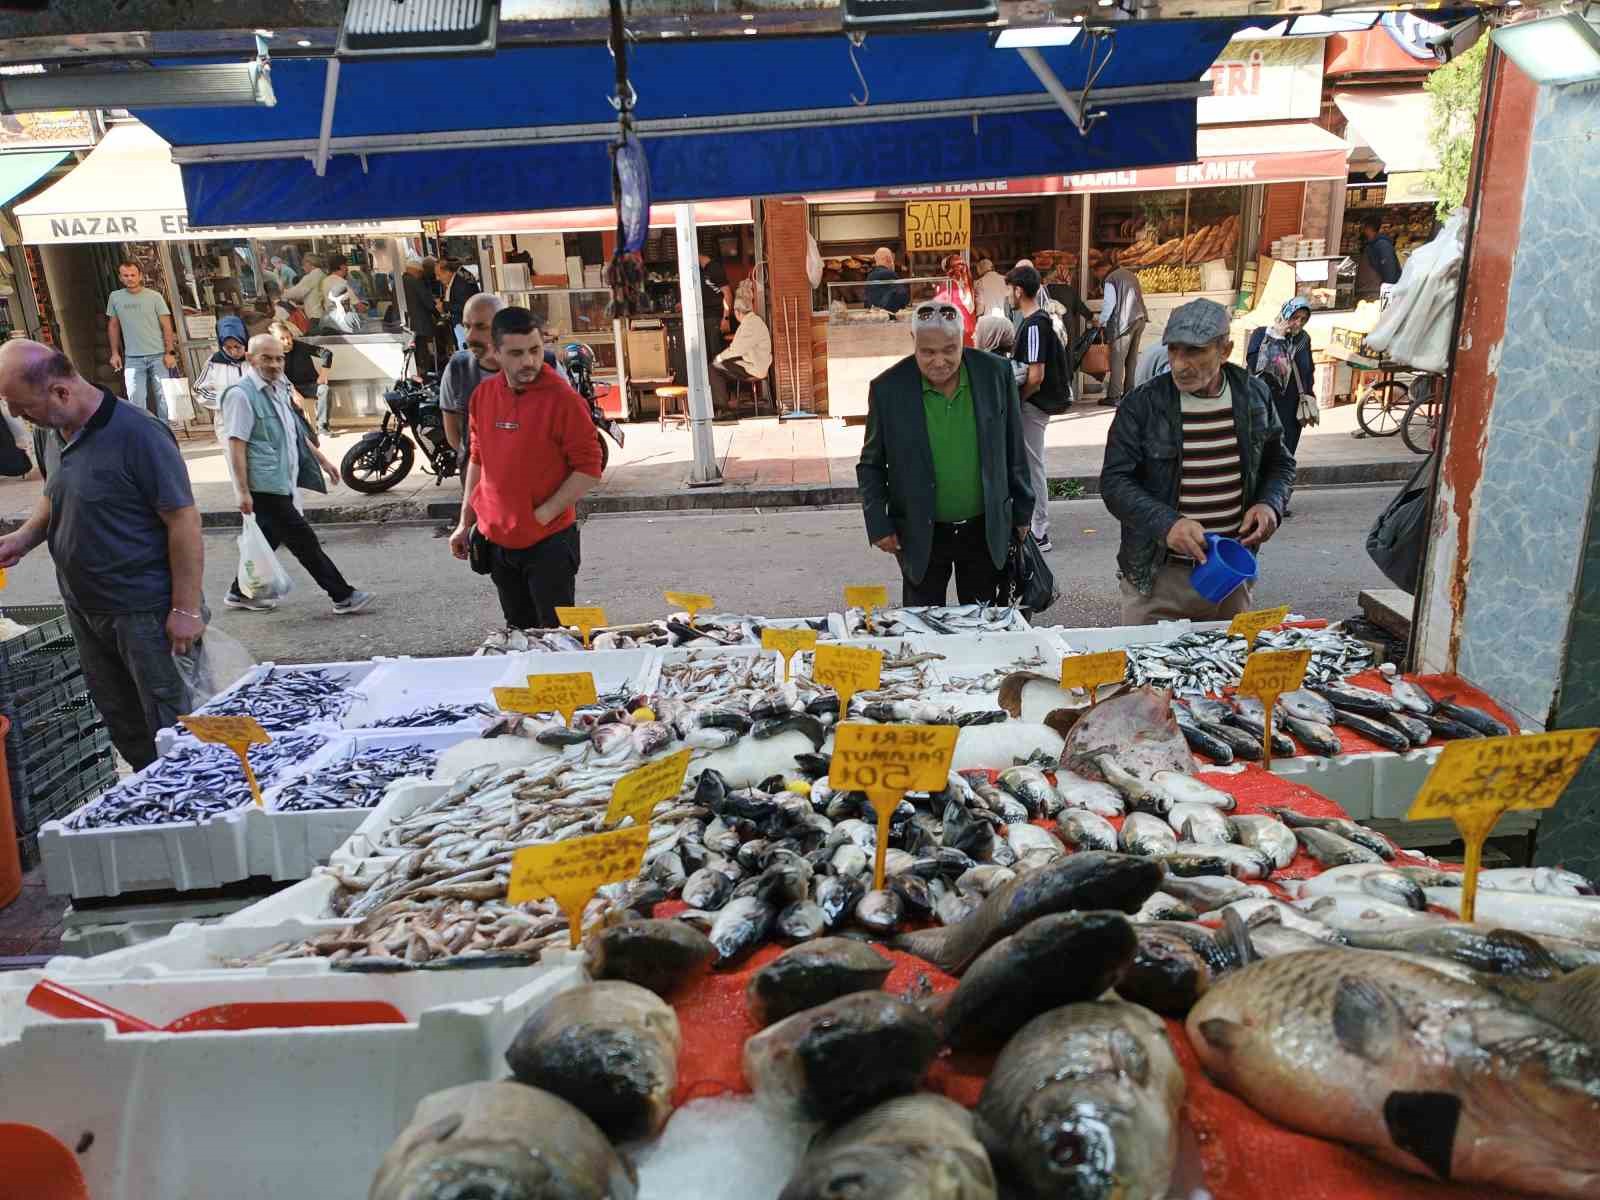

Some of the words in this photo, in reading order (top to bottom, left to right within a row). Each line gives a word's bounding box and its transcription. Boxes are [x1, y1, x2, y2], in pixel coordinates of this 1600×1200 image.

[1176, 160, 1256, 183] EKMEK
[50, 216, 139, 238] NAZAR
[907, 203, 964, 232] SARI
